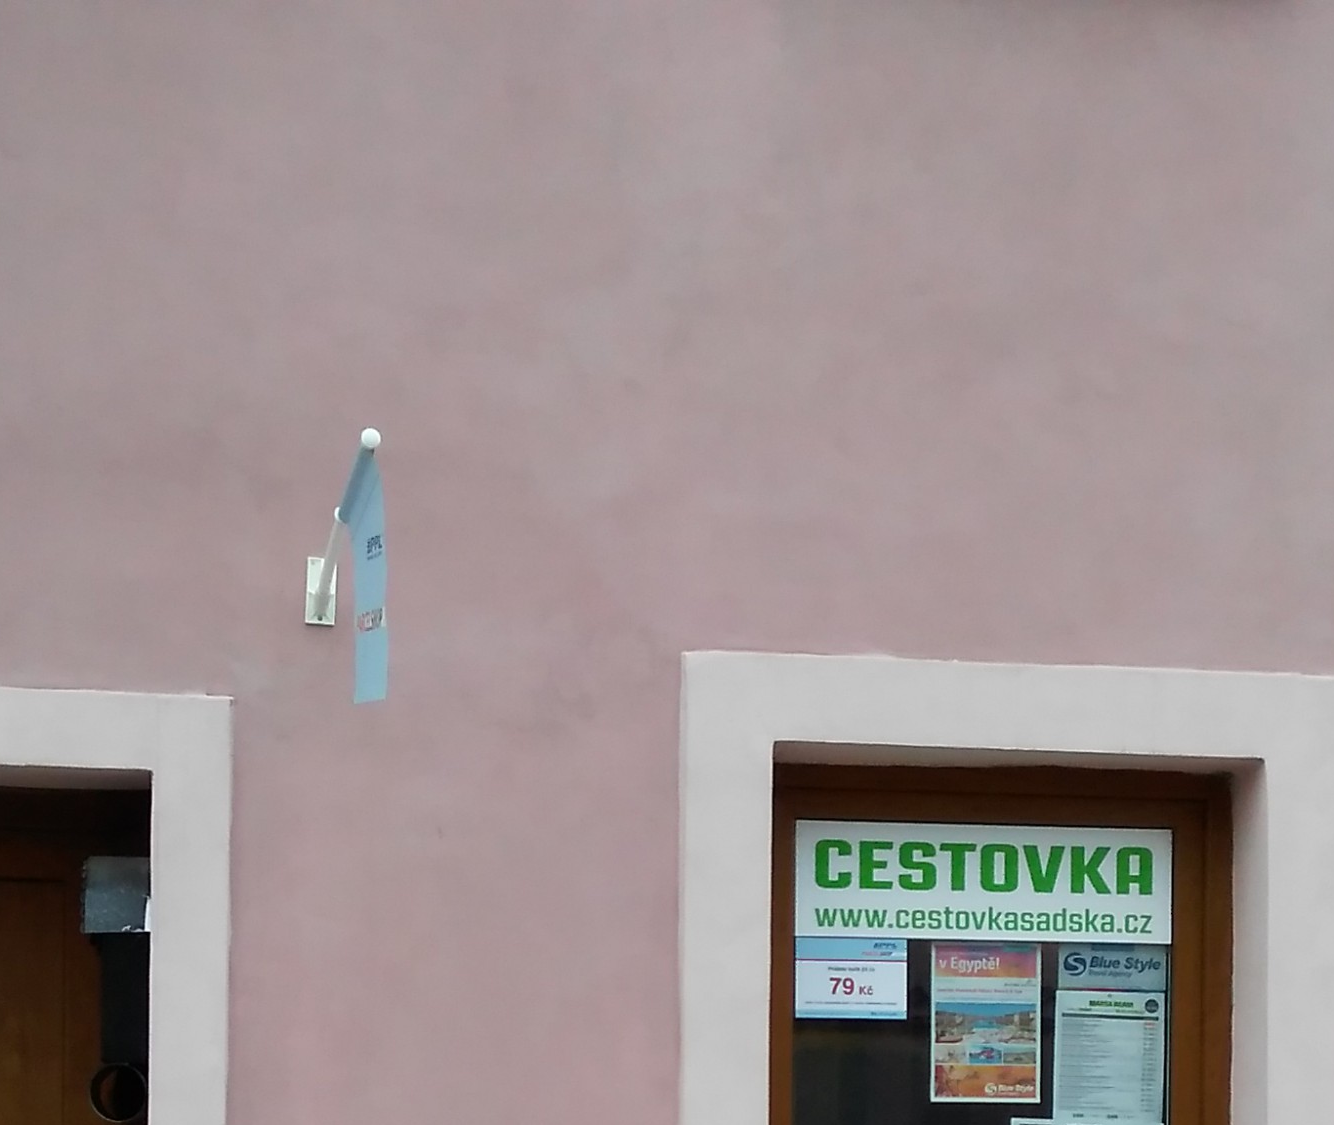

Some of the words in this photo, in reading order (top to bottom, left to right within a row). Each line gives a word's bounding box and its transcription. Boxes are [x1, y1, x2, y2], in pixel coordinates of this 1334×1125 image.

[814, 838, 1153, 895] CESTOVKA
[814, 906, 1153, 934] www.cestovkasadska.cz
[938, 960, 947, 969] v
[950, 956, 1000, 973] Egyptě!
[1089, 956, 1121, 968] Blue
[1124, 956, 1161, 974] Style
[829, 977, 855, 995] 79
[858, 985, 874, 995] Kč
